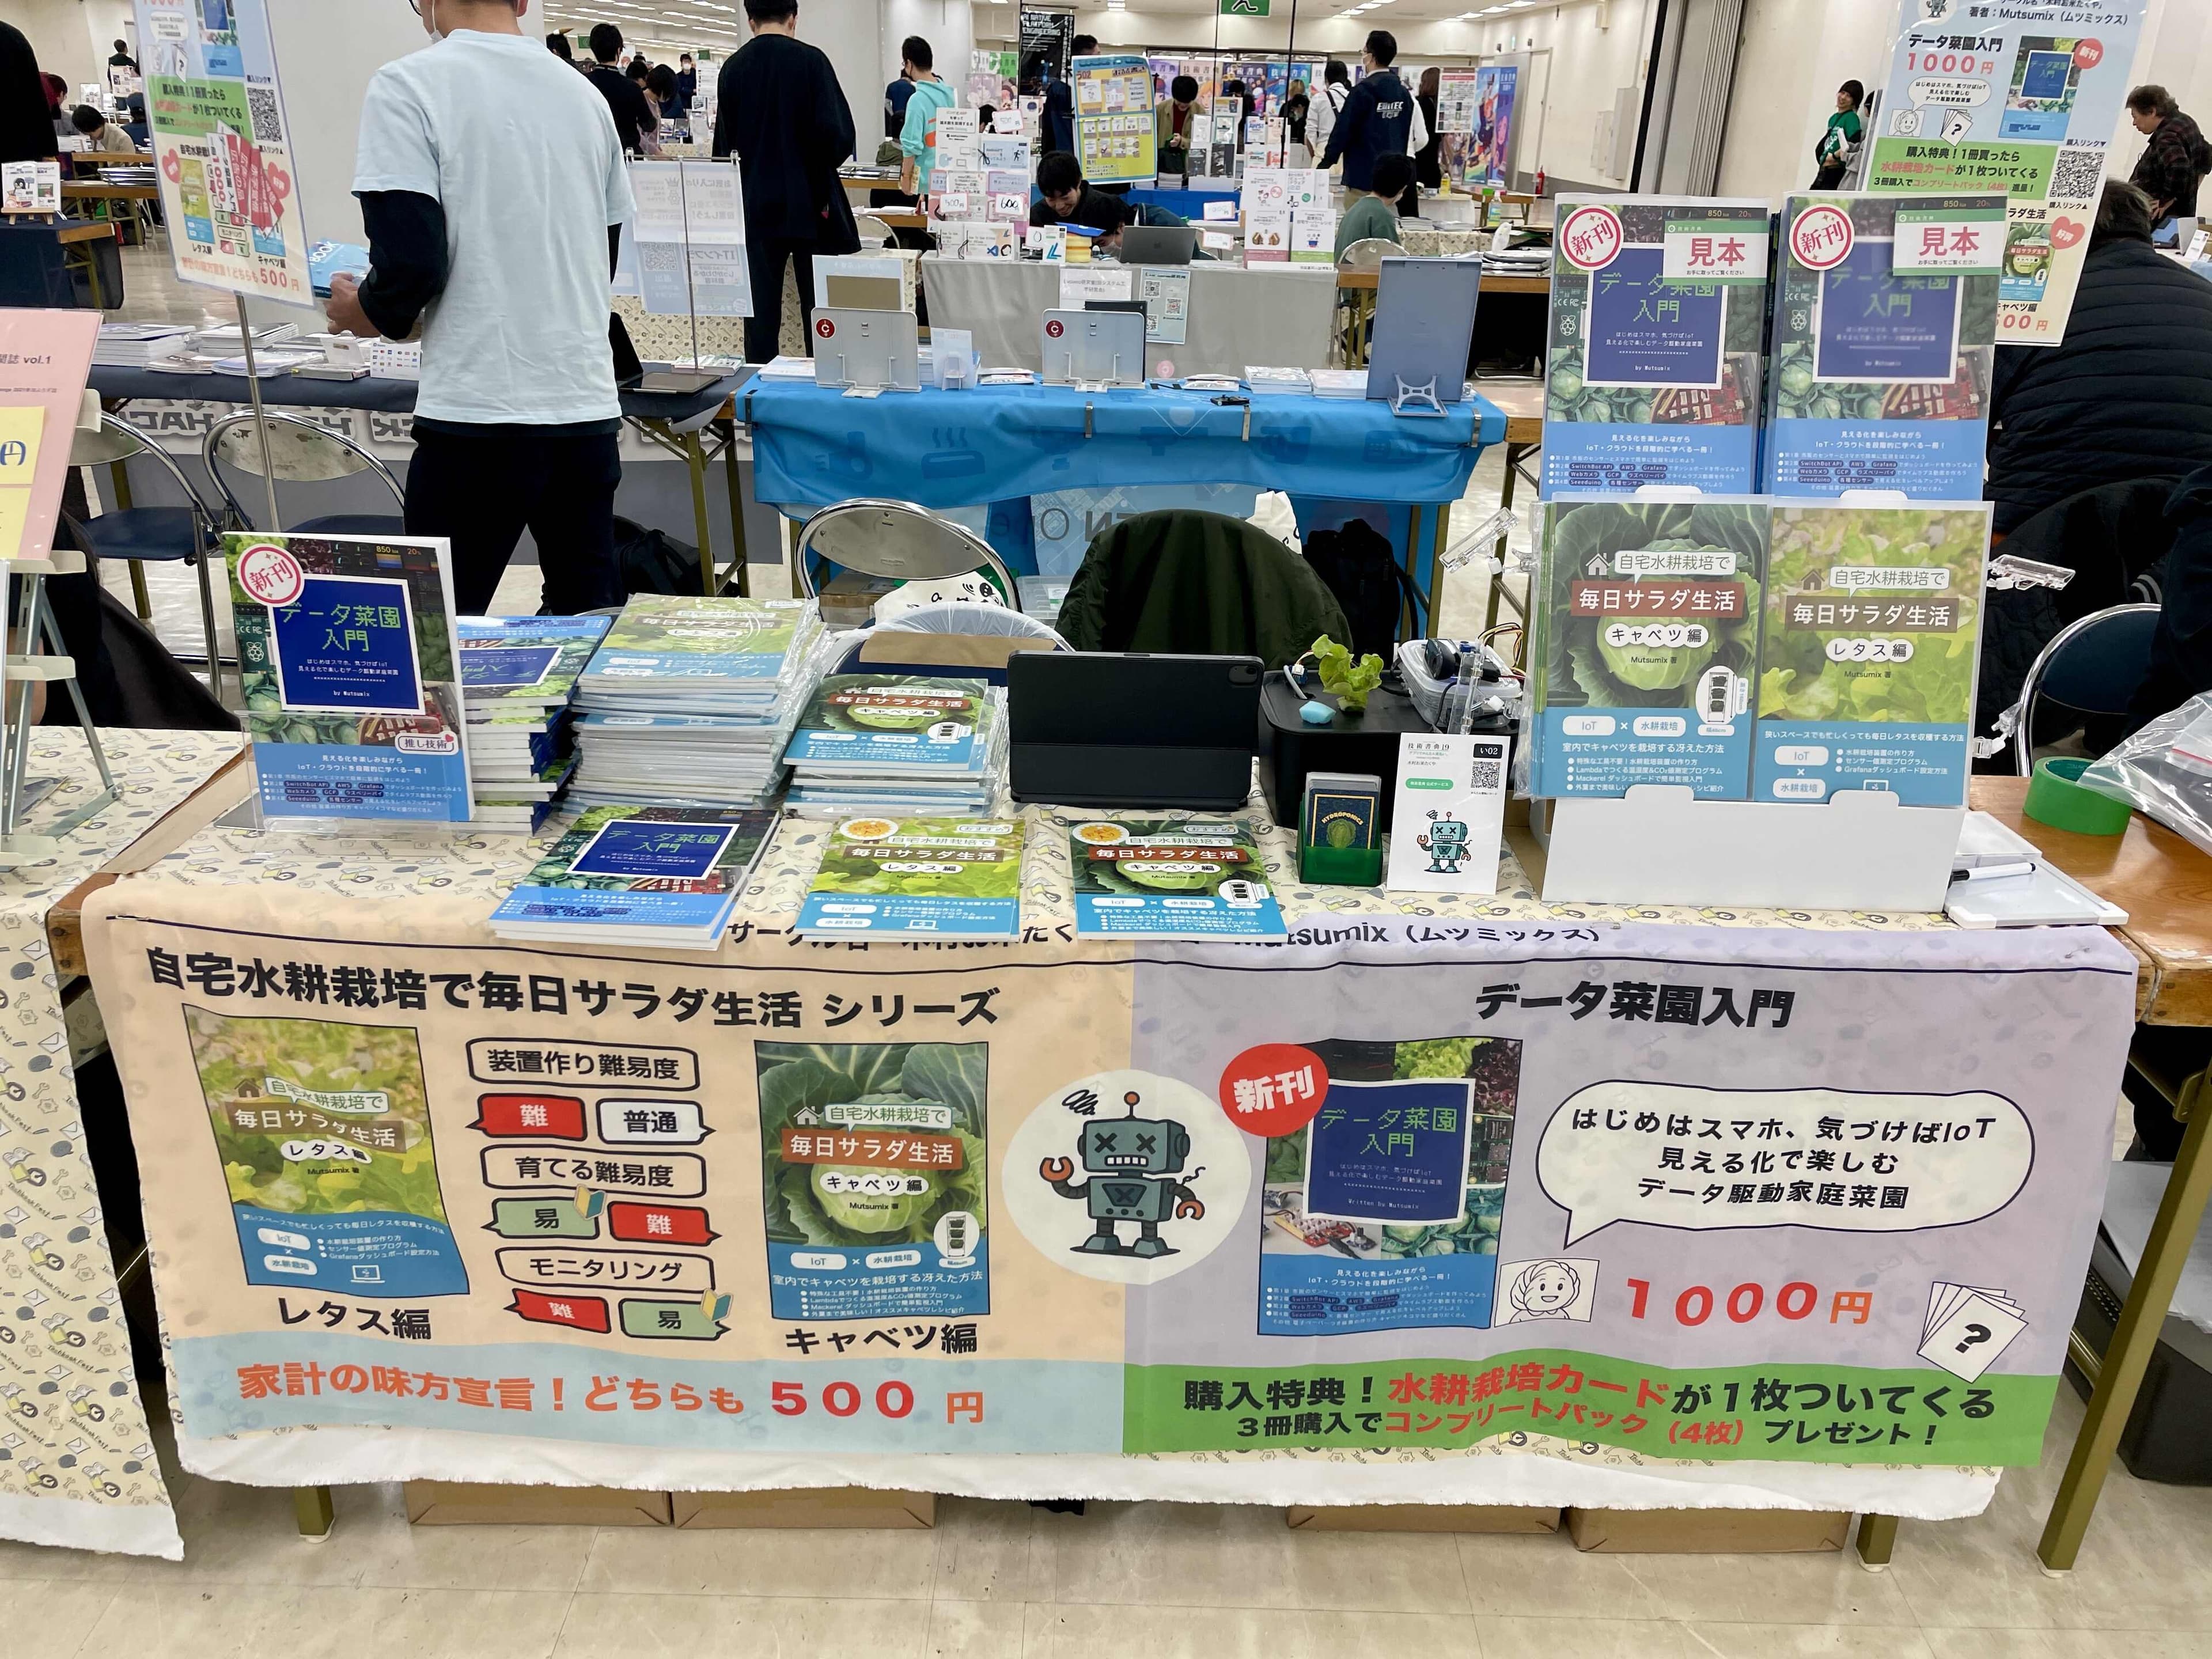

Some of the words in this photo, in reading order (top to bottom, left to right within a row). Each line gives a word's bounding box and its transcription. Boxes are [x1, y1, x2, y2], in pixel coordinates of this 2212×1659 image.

[1908, 34, 2003, 52] データ菜園入門
[1908, 52, 1976, 74] 1000
[1980, 61, 1995, 74] 円
[1571, 219, 1613, 256] 新刊
[1800, 222, 1844, 253] 新刊
[1919, 226, 1979, 256] 見本
[1687, 237, 1746, 266] 見本
[260, 268, 287, 288] 500
[1633, 299, 1680, 323] 入門
[1863, 293, 1912, 317] 入門
[376, 544, 391, 554] 850
[1620, 554, 1730, 571] 自宅水耕栽培で
[249, 560, 295, 593] 新刊
[1835, 569, 1945, 588] 自宅水耕栽培で
[1579, 589, 1736, 612] 毎日サラダ生活
[279, 603, 401, 629] データ菜園
[1793, 603, 1951, 626] 毎日サラダ生活
[321, 629, 370, 652] 入門
[1611, 627, 1703, 643] キャベツ編
[1631, 656, 1667, 664] Mutsumix
[1670, 656, 1677, 664] 著
[1832, 642, 1907, 658] レタス編
[1844, 671, 1881, 679] Mutsumix
[334, 690, 341, 698] by
[835, 696, 963, 708] 毎日サラダ生活
[860, 707, 935, 716] キャベツ編
[1582, 721, 1597, 730] IoT
[1641, 721, 1679, 731] 水耕栽培
[404, 738, 448, 749] 推し技術
[1562, 743, 1725, 754] 室内でキャベツを栽培する冴えた方法
[1794, 751, 1810, 760] IoT
[1781, 783, 1818, 793] 水耕栽培
[1321, 810, 1364, 826] HYDROPONICS
[608, 829, 721, 844] データ菜園
[891, 837, 993, 846] 自宅水耕栽培で
[1130, 837, 1228, 845] 自宅水耕栽培で
[632, 843, 682, 854] 入門
[851, 847, 997, 861] 毎日サラダ生活
[1096, 849, 1239, 860] 毎日サラダ生活
[887, 863, 956, 872] レタス編
[1130, 863, 1215, 872] キャベツ編
[147, 947, 802, 1028] 自宅水耕栽培で毎日サラダ生活
[823, 986, 1001, 1028] シリーズ
[1474, 980, 1796, 1030] データ菜園入門
[487, 1048, 680, 1081] 装置作り難易度
[272, 1080, 385, 1112] 自宅水耕栽培で
[1232, 1064, 1317, 1115] 新刊
[520, 1104, 548, 1128] 難
[623, 1109, 679, 1134] 普通
[830, 1105, 948, 1124] 自宅水耕栽培で
[1320, 1106, 1459, 1135] データ菜園
[234, 1108, 396, 1149] 毎日サラダ生活
[1572, 1108, 1997, 1146] はじめはスマホ、気づけばIoT
[289, 1143, 368, 1162] レタス編
[790, 1135, 954, 1164] 毎日サラダ生活
[1359, 1132, 1415, 1158] 入門
[306, 1167, 350, 1176] Mutsumix
[1657, 1146, 1900, 1176] 見える化で楽しむ
[515, 1156, 675, 1188] 育てる難易度
[827, 1175, 923, 1194] キャベツ編
[1638, 1177, 1910, 1211] データ駆動家庭菜園
[849, 1202, 889, 1212] Mutsumix
[1348, 1198, 1376, 1207] Written
[1388, 1200, 1421, 1210] Mutsumix
[534, 1208, 560, 1229] 易
[645, 1214, 673, 1235] 難
[529, 1257, 683, 1281] モニタリング
[810, 1257, 826, 1266] IoT
[873, 1253, 913, 1264] 水耕栽培
[772, 1270, 983, 1287] 室内でキャベツを栽培する冴えた方法
[1624, 1277, 1819, 1327] 1000
[1831, 1290, 1873, 1325] 円
[276, 1297, 432, 1341] レタス編
[547, 1302, 574, 1319] 難
[657, 1310, 683, 1330] 易
[785, 1323, 978, 1355] キャベツ編
[236, 1362, 745, 1416] 家計の味方宣言！どちらも
[771, 1380, 916, 1419] 500
[947, 1391, 984, 1423] 円
[1766, 1415, 1937, 1448] プレゼント！
